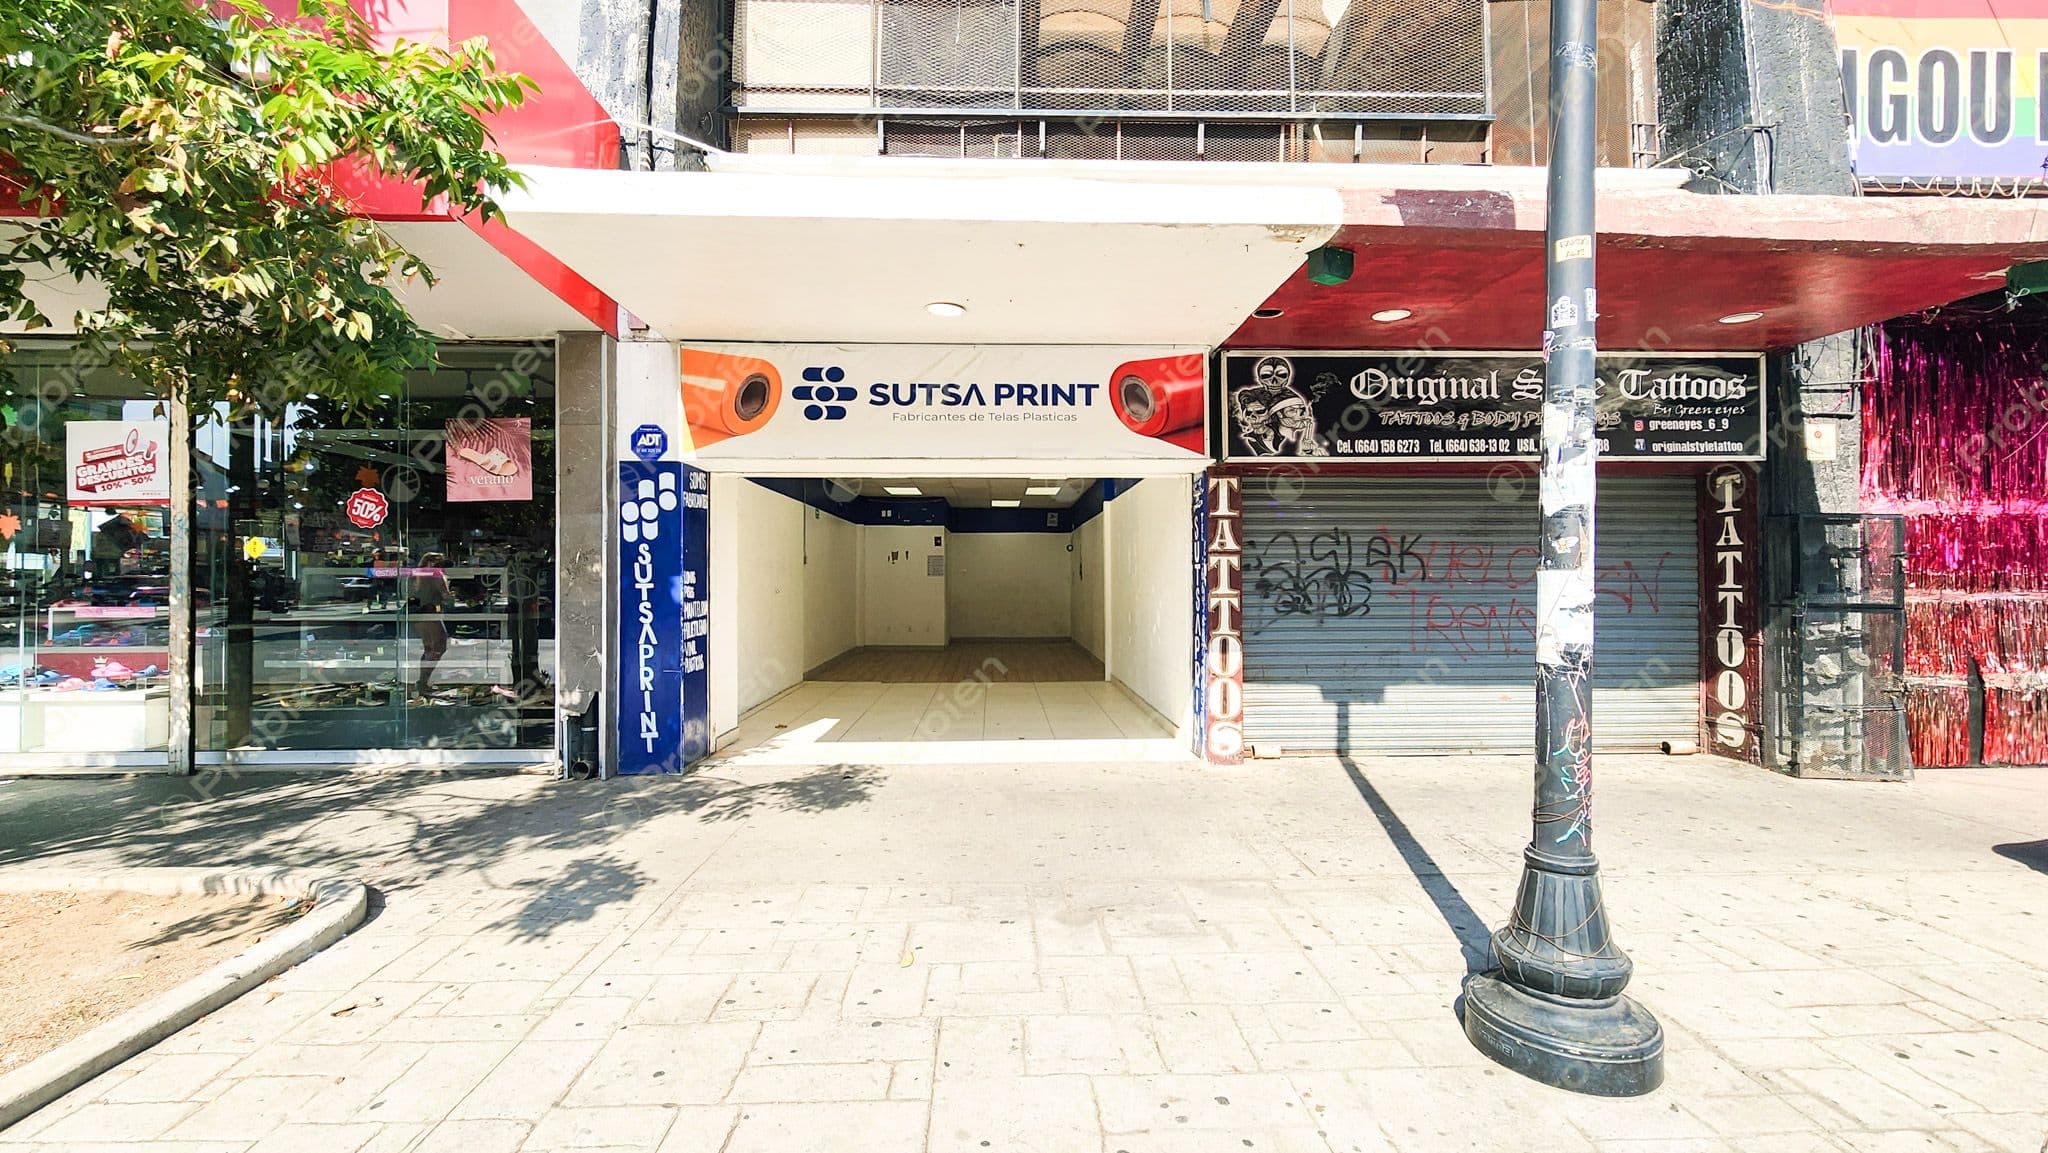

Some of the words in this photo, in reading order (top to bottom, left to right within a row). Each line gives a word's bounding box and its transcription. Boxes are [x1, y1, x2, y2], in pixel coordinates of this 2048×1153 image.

[869, 383, 986, 406] SUTSA
[994, 384, 1100, 406] PRINT
[1350, 367, 1501, 405] Original
[1616, 368, 1748, 401] Tattoos
[892, 412, 966, 422] Fabricantes
[969, 412, 985, 422] de
[989, 412, 1020, 422] Telas
[1023, 412, 1078, 422] Plasticas
[1653, 402, 1672, 417] By
[1379, 410, 1455, 426] TATTOOS
[1472, 410, 1521, 431] BODY
[1649, 418, 1730, 432] greeneyes_6_9
[637, 433, 661, 446] ADT
[1337, 439, 1353, 453] Cel.
[1355, 439, 1379, 454] (664)
[1380, 439, 1395, 453] 158
[1397, 439, 1420, 453] 6273
[1429, 439, 1444, 453] Tel.
[1445, 439, 1468, 453] (664)
[1469, 439, 1498, 453] 638-13
[1499, 439, 1510, 453] 02
[1517, 438, 1538, 453] USA.
[1652, 441, 1744, 453] originalstyletattoo
[77, 455, 145, 477] GRANDES
[78, 464, 155, 487] DESCUENTOS
[101, 481, 122, 492] 10%
[131, 475, 153, 486] 50%
[470, 475, 514, 485] verano
[352, 497, 384, 522] 50%
[1208, 477, 1242, 758] TATTOOS
[1715, 473, 1746, 748] TATTOOS
